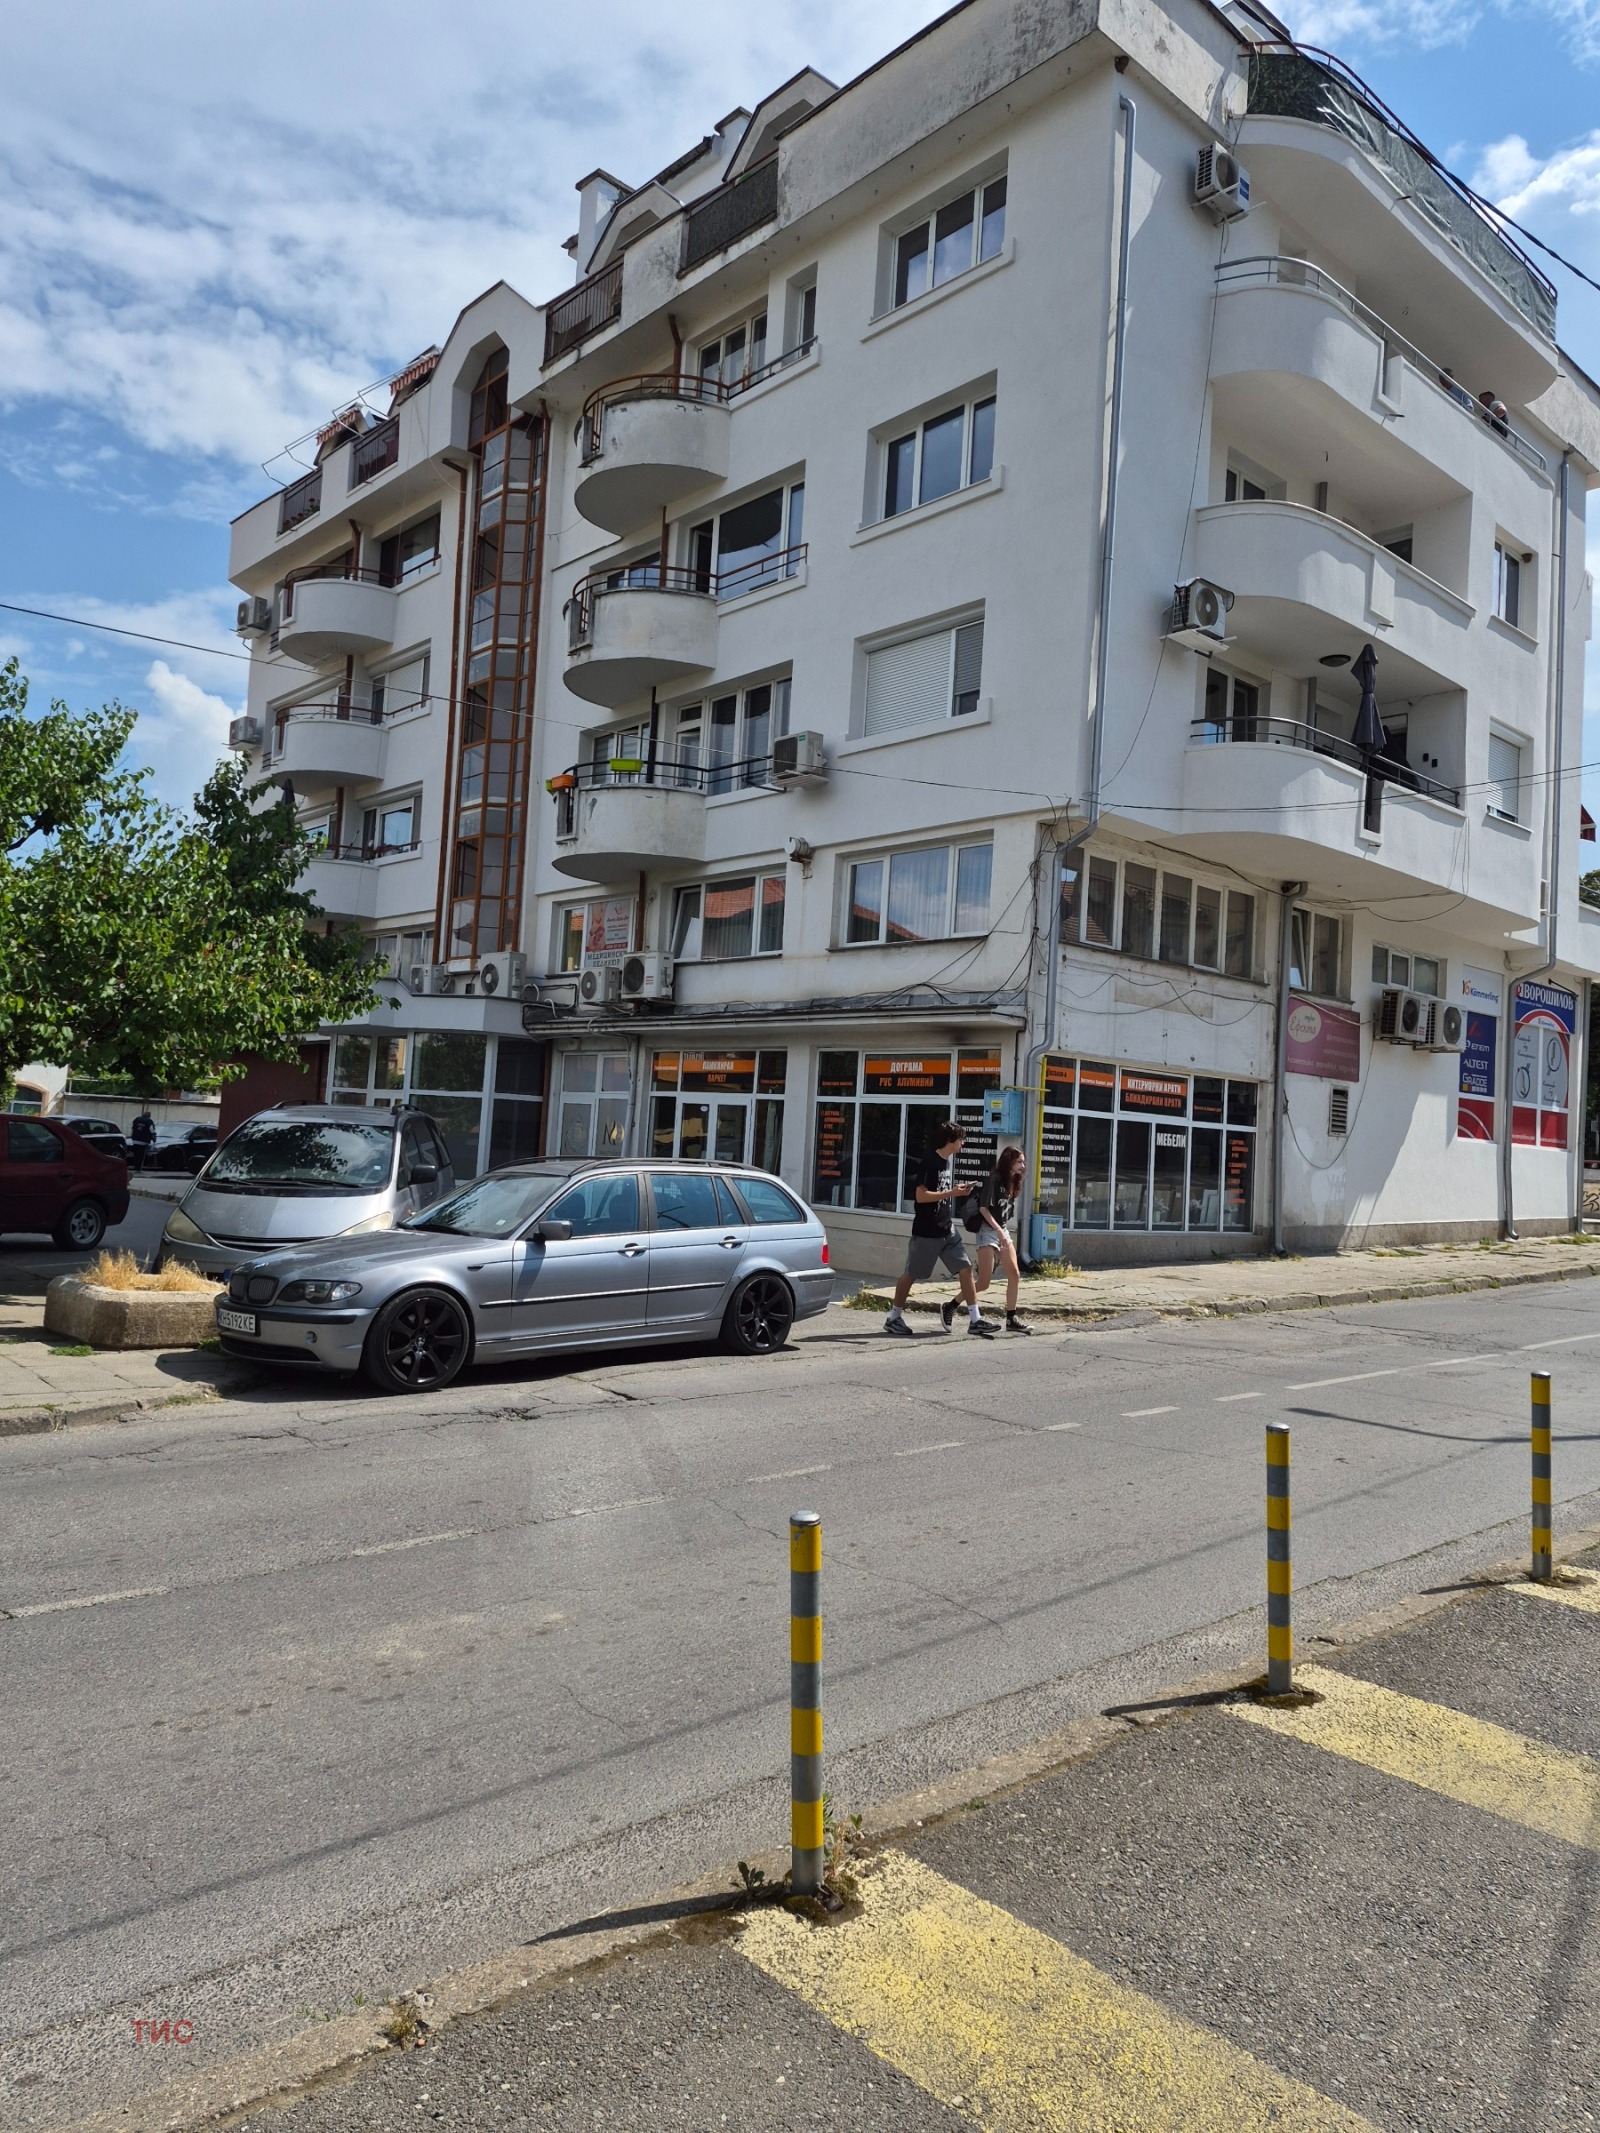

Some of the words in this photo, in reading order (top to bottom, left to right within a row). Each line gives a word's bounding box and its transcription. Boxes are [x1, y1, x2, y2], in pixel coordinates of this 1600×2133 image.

[1524, 983, 1574, 1011] ВОРОШИЛОВ
[890, 1062, 923, 1073] ДОГРАМА
[1156, 1133, 1186, 1148] МЕБЕЛИ
